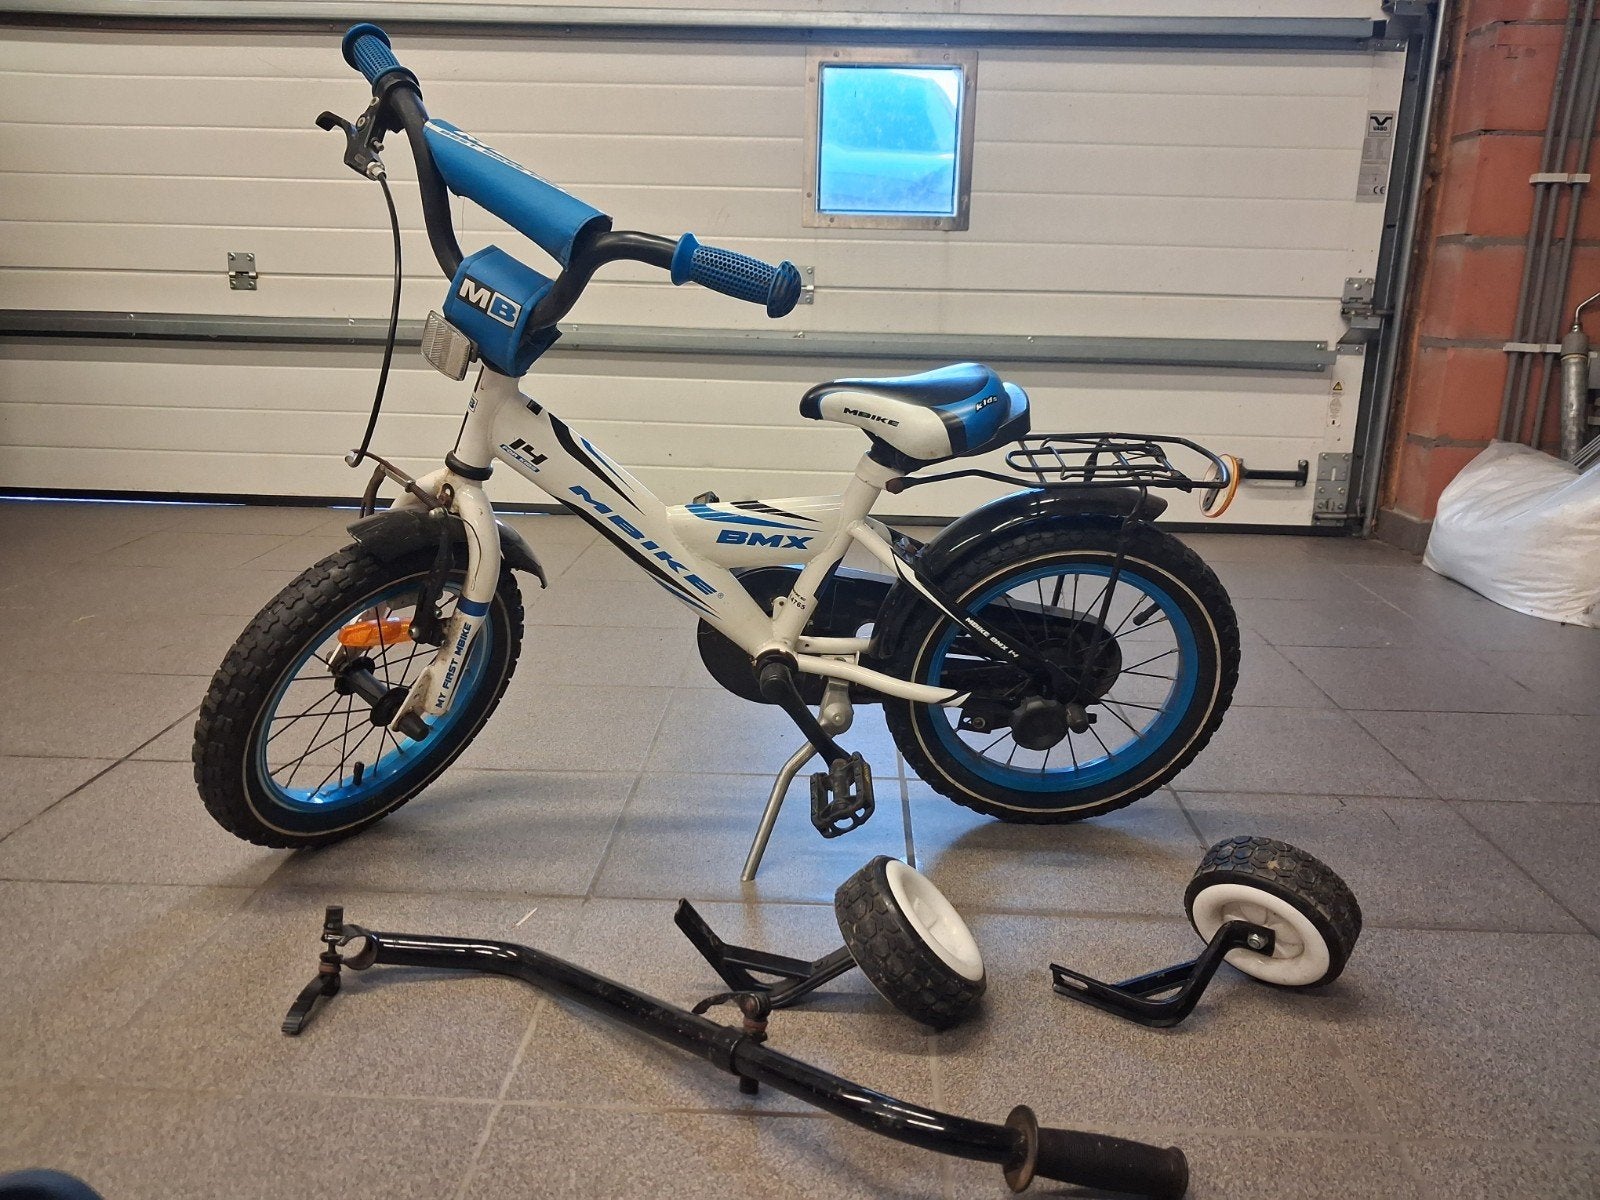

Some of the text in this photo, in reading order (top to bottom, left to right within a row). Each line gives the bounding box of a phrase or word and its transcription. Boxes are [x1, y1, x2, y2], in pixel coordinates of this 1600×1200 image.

[459, 278, 521, 328] MB
[843, 407, 900, 427] MBIKE
[509, 438, 549, 465] 14
[569, 485, 717, 596] MBIKE
[716, 529, 814, 550] BMX
[965, 617, 990, 637] MBIKE
[990, 636, 1009, 651] BMX
[435, 622, 471, 708] MY FIRST MBIKE
